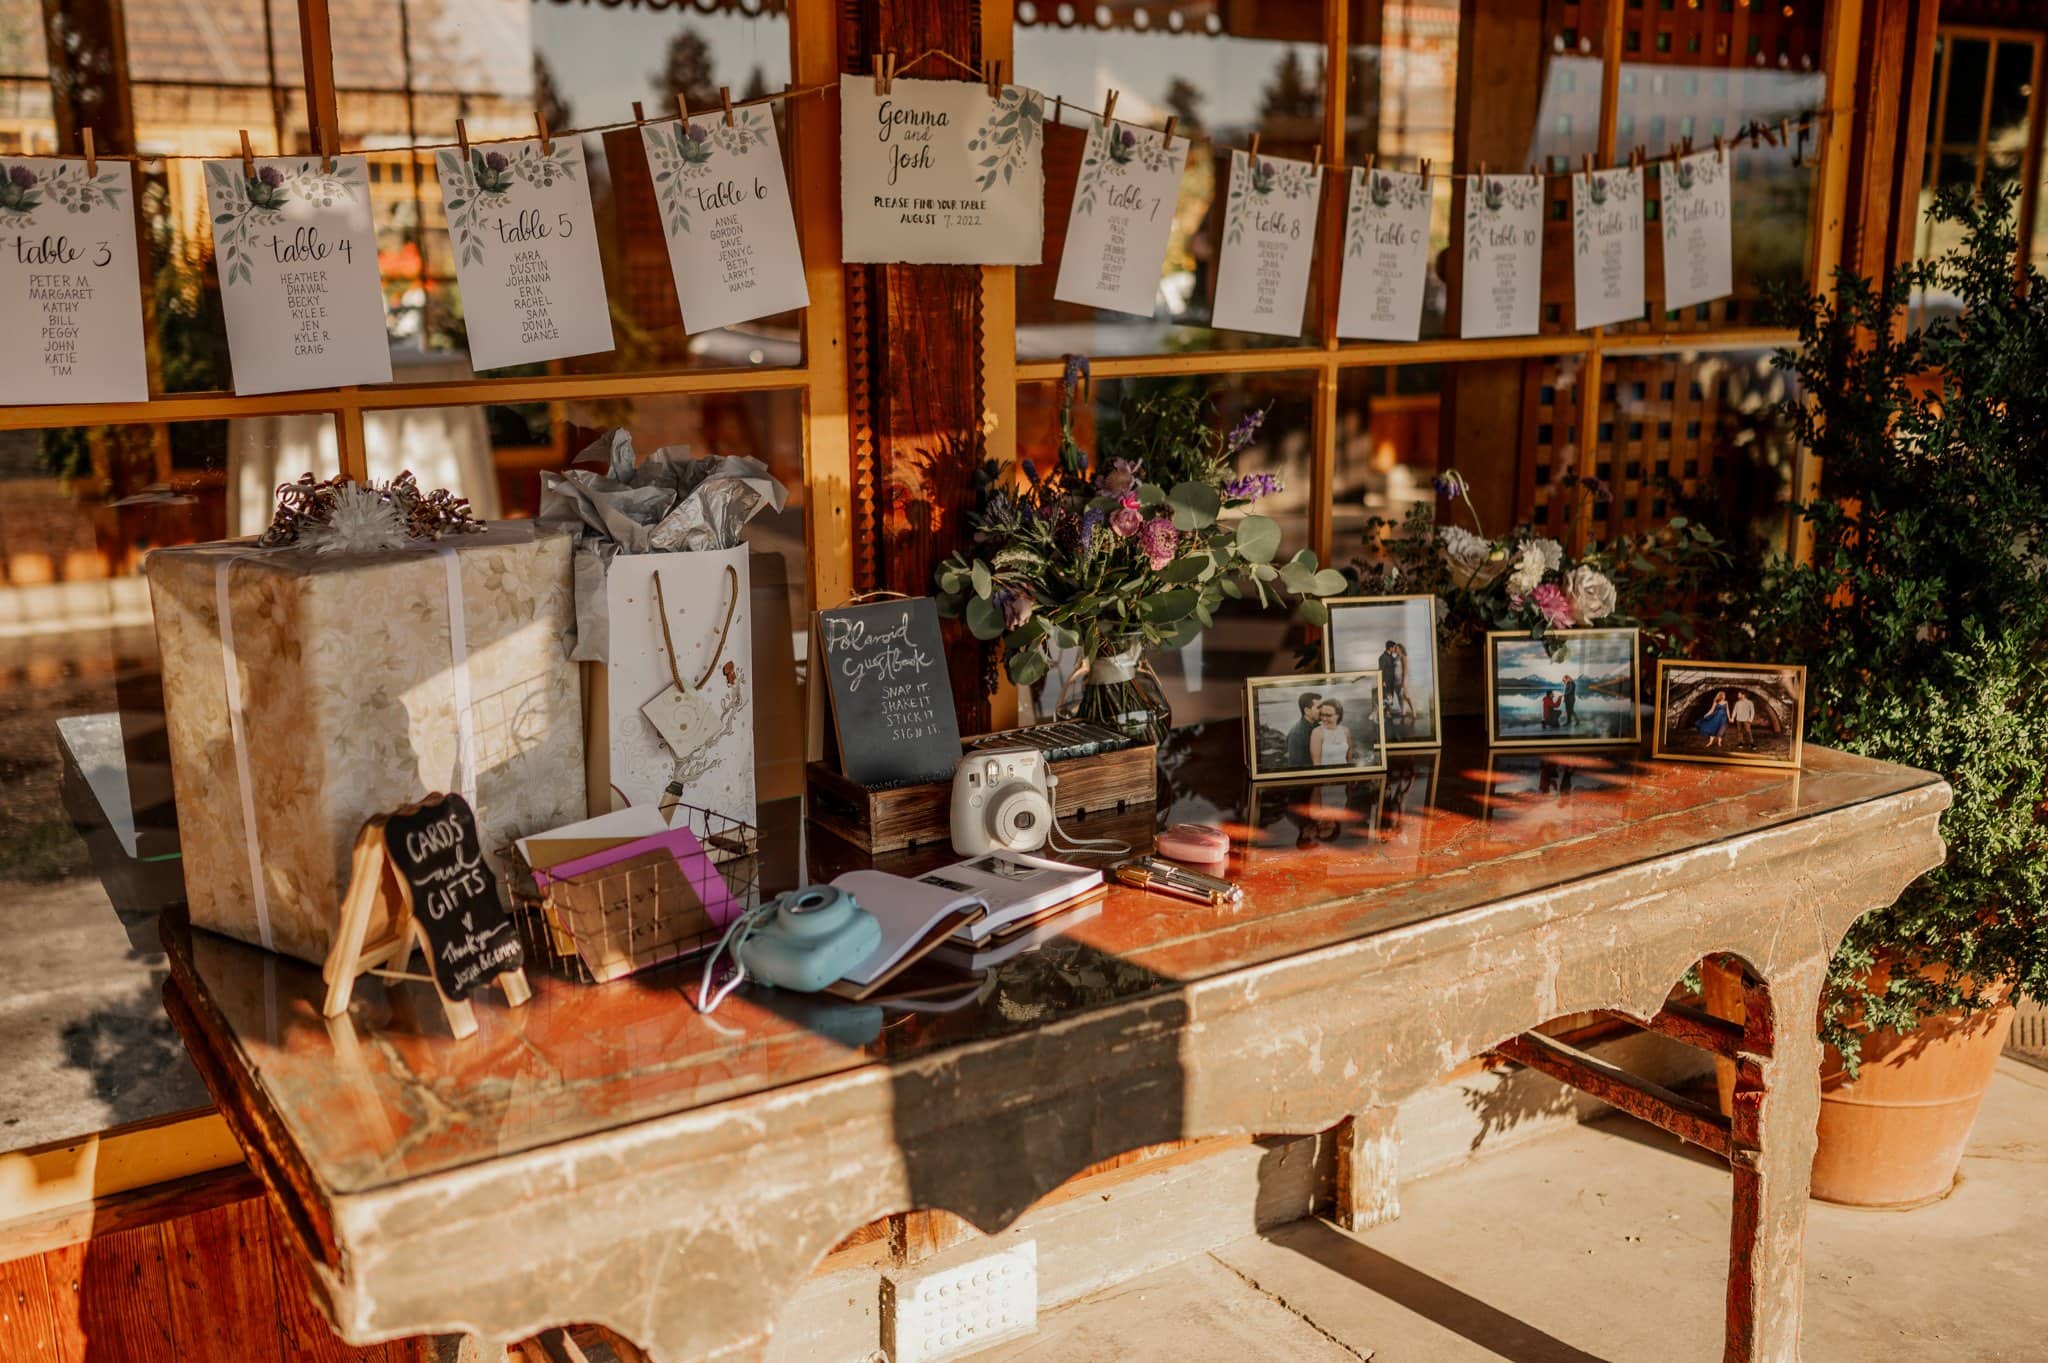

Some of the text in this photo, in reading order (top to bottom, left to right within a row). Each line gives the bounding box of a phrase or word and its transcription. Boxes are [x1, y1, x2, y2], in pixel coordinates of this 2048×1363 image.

[878, 100, 949, 142] Gemma
[904, 126, 933, 142] and
[887, 143, 936, 186] Josh
[688, 177, 768, 212] table 6
[874, 196, 986, 211] PLEASE FIND YOUR TABLE
[1106, 184, 1161, 222] table 7
[492, 208, 572, 243] table 5
[715, 214, 738, 228] ANNE
[900, 213, 936, 225] AUGUST
[956, 215, 982, 226] 2022
[1254, 211, 1300, 240] table 8
[710, 224, 744, 240] GORDON
[1374, 222, 1405, 246] table
[1523, 229, 1536, 247] 10
[264, 226, 352, 264] table 4
[720, 236, 742, 249] DAVE
[8, 235, 112, 267] table 3
[515, 250, 540, 263] KARA
[718, 246, 745, 262] JENNY
[510, 260, 548, 275] DUSTIN
[726, 257, 748, 271] BETH
[30, 274, 71, 287] PETER
[280, 271, 327, 284] HEATHER
[505, 273, 551, 287] JOHANNA
[722, 268, 748, 283] LARRY
[28, 288, 95, 300] MARGARET
[287, 283, 328, 295] DHAWAL
[520, 286, 543, 298] ERIK
[43, 301, 80, 313] KATHY
[288, 295, 320, 308] BECKY
[514, 296, 552, 309] RACHEL
[49, 315, 74, 326] BILL
[292, 308, 317, 320] KYLE
[527, 308, 548, 320] SAM
[300, 320, 319, 331] JEN
[42, 327, 80, 339] PEGGY
[294, 331, 319, 343] KYLE
[522, 329, 559, 343] CHANCE
[44, 340, 75, 351] JOHN
[295, 344, 323, 355] CRAIG
[44, 352, 78, 364] KATIE
[50, 365, 72, 376] TIM
[826, 612, 918, 654] Polaroid
[882, 684, 912, 699] SNAP
[881, 698, 918, 714] SHAKE
[887, 711, 922, 727] STICK
[893, 728, 922, 741] SIGN
[406, 814, 464, 863] CARDS
[414, 844, 482, 885] and
[428, 869, 485, 920] GIFTS
